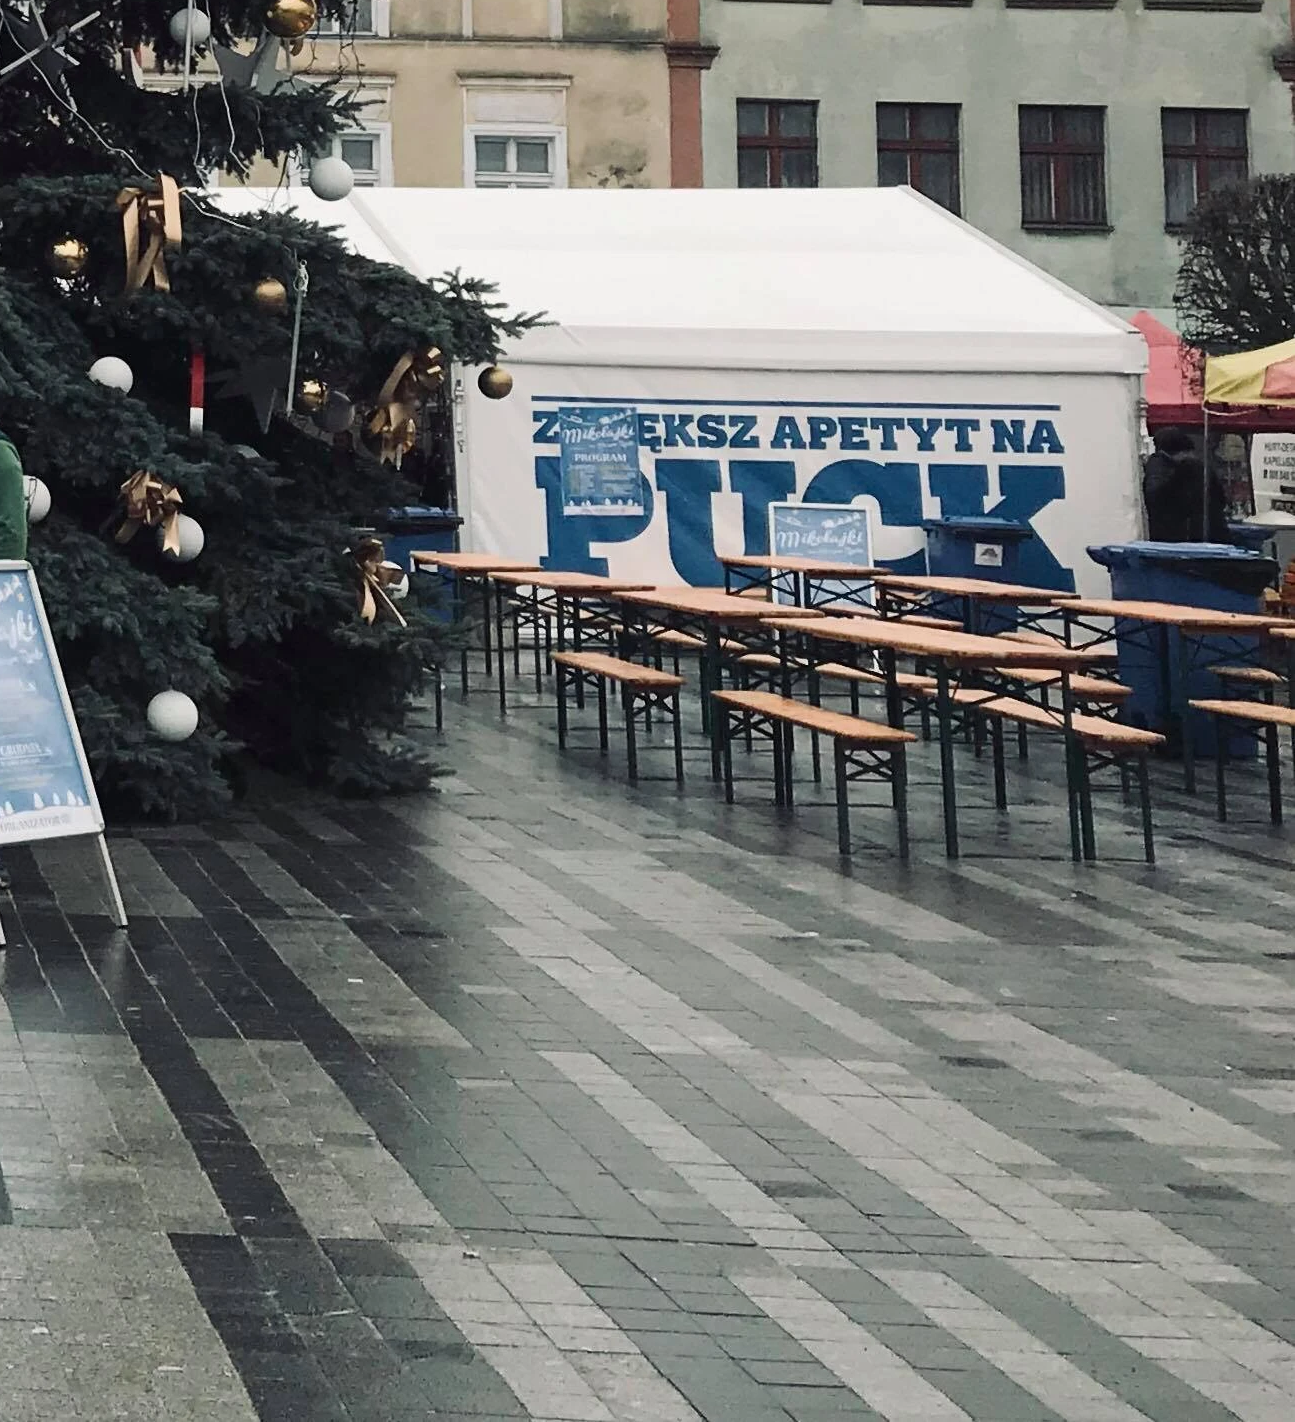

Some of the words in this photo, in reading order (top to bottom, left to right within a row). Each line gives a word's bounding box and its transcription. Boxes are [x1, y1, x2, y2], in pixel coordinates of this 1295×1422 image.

[532, 410, 761, 454] ZĘKSZ
[771, 416, 980, 452] APETYT
[991, 419, 1065, 454] NA
[574, 453, 627, 463] PROGRAM
[535, 456, 1076, 594] PUCK
